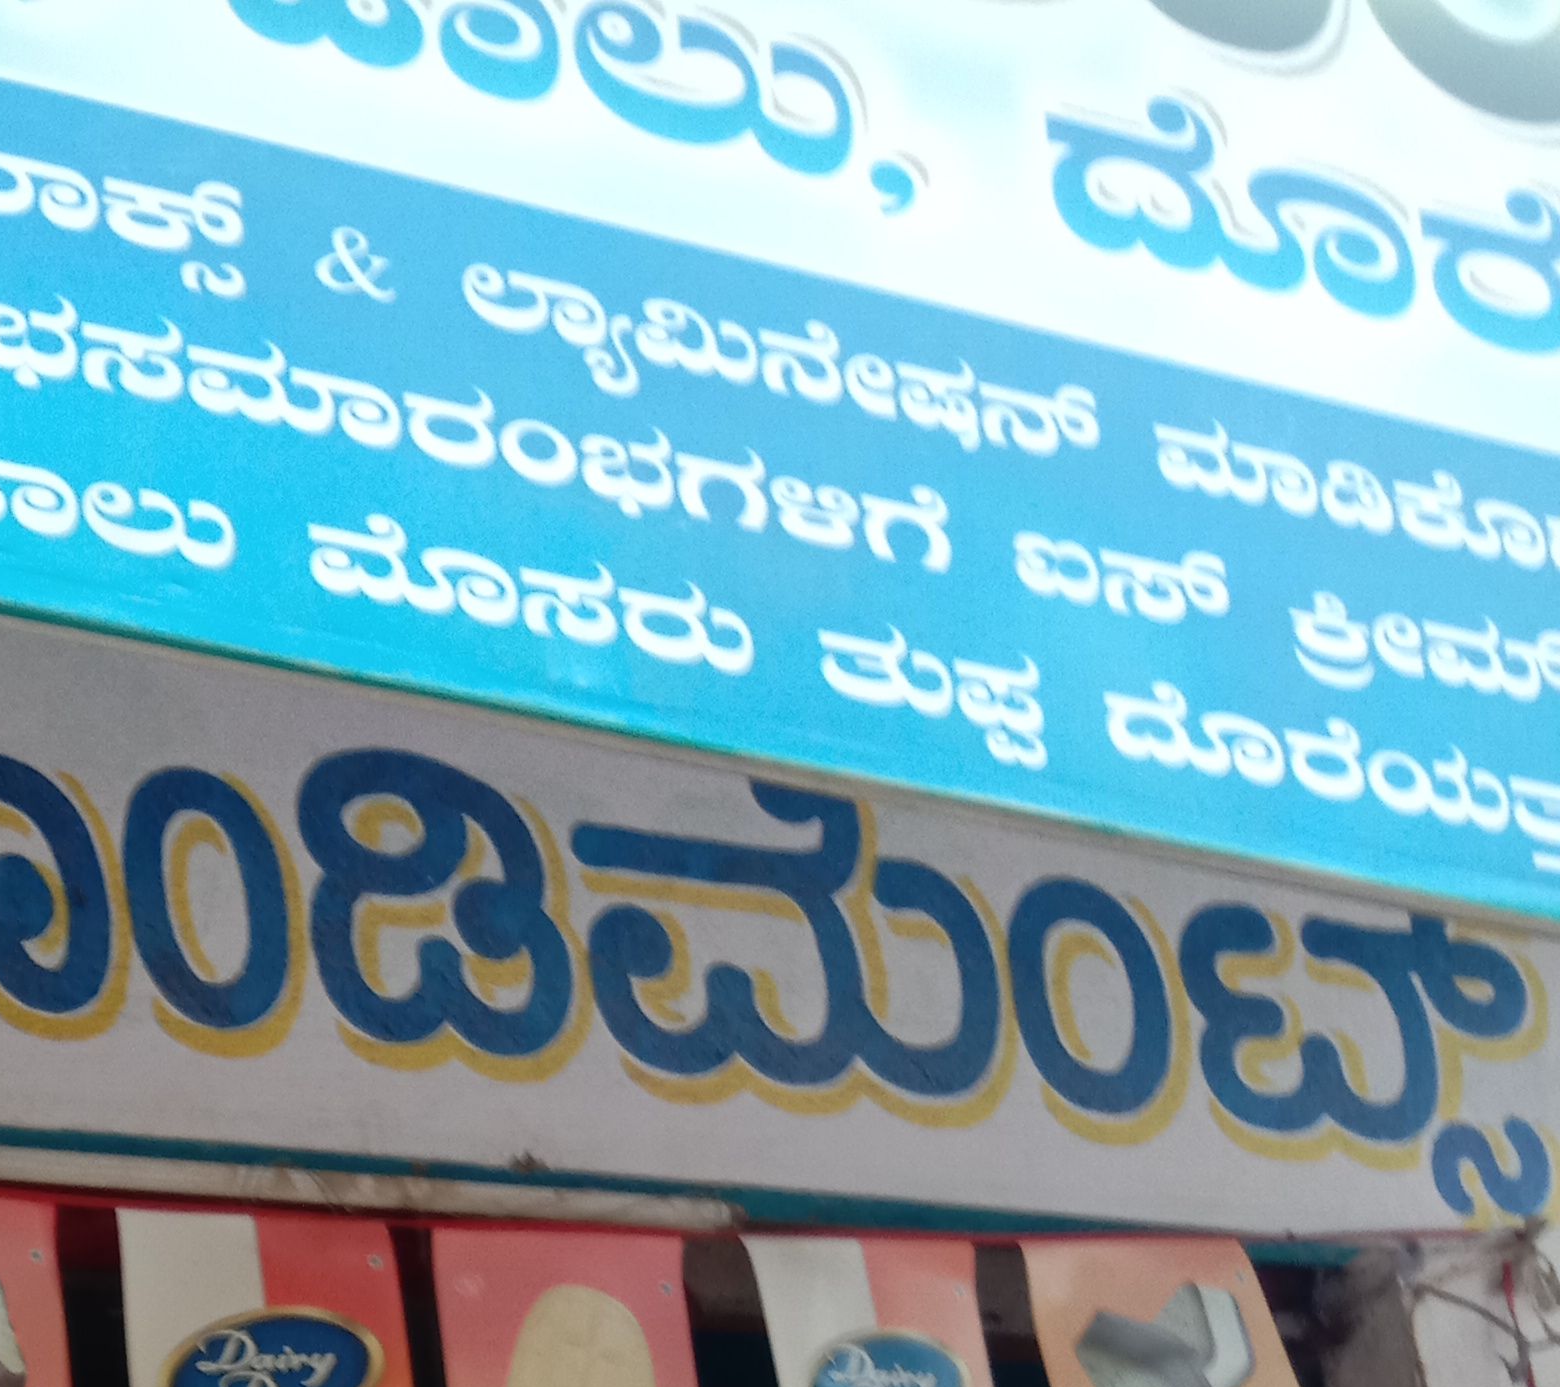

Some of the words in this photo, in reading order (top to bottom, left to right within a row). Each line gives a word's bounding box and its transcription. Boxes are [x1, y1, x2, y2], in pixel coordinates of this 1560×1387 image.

[316, 226, 397, 302] &
[462, 261, 1101, 457] ಲ್ಯಾಮಿನೇಷನ್
[1153, 417, 1560, 570] ಮಾಡಿಕೊ
[307, 513, 756, 676] ಮೊಸರು
[818, 620, 1048, 771] ತುಪ್ಪ
[1012, 530, 1230, 624] ಐಸ್
